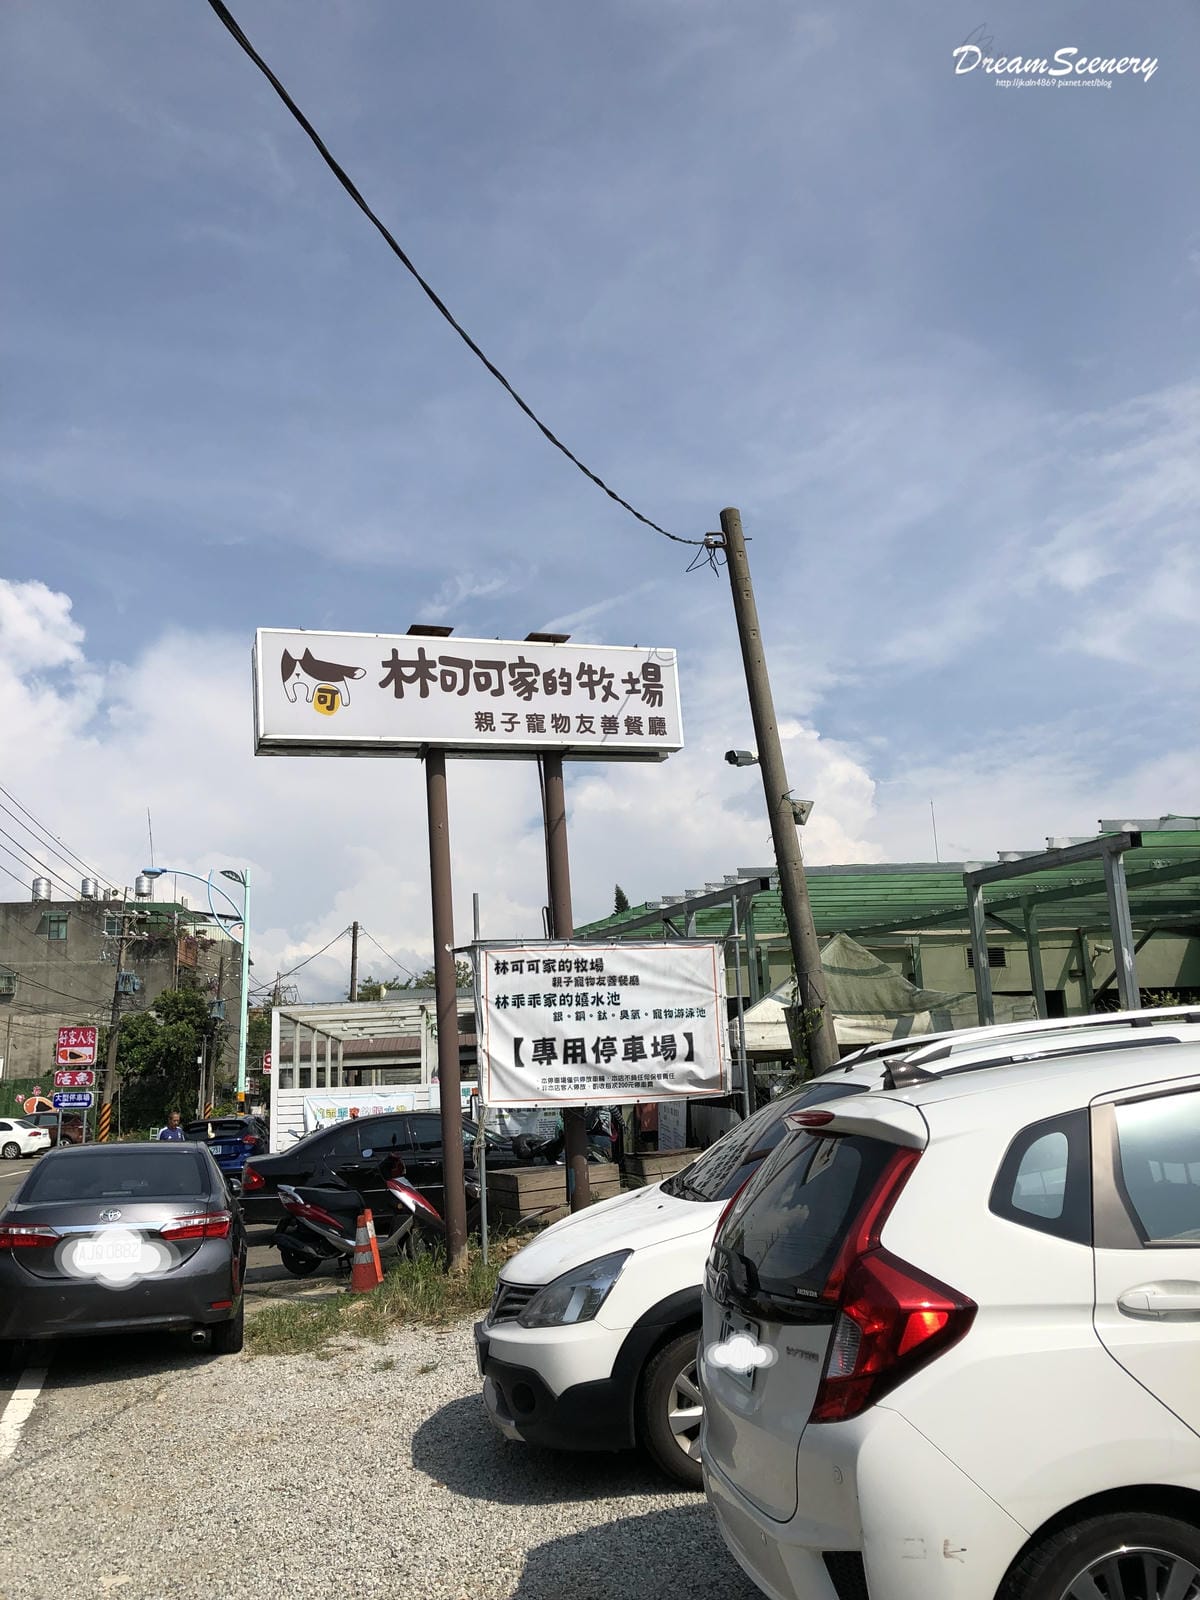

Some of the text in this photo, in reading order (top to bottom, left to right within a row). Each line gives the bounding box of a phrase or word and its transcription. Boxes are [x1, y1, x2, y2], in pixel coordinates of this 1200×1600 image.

[379, 647, 664, 707] 林可可家的牧場
[317, 687, 340, 711] 可
[474, 711, 668, 736] 親子寵物友善餐廳
[494, 958, 604, 975] 林可可家的牧場
[552, 975, 640, 988] 親子寵物友善餐廳
[495, 992, 621, 1009] 林乖乖家的嬉水池
[59, 1031, 95, 1045] 好客人家
[57, 1072, 90, 1085] 活魚
